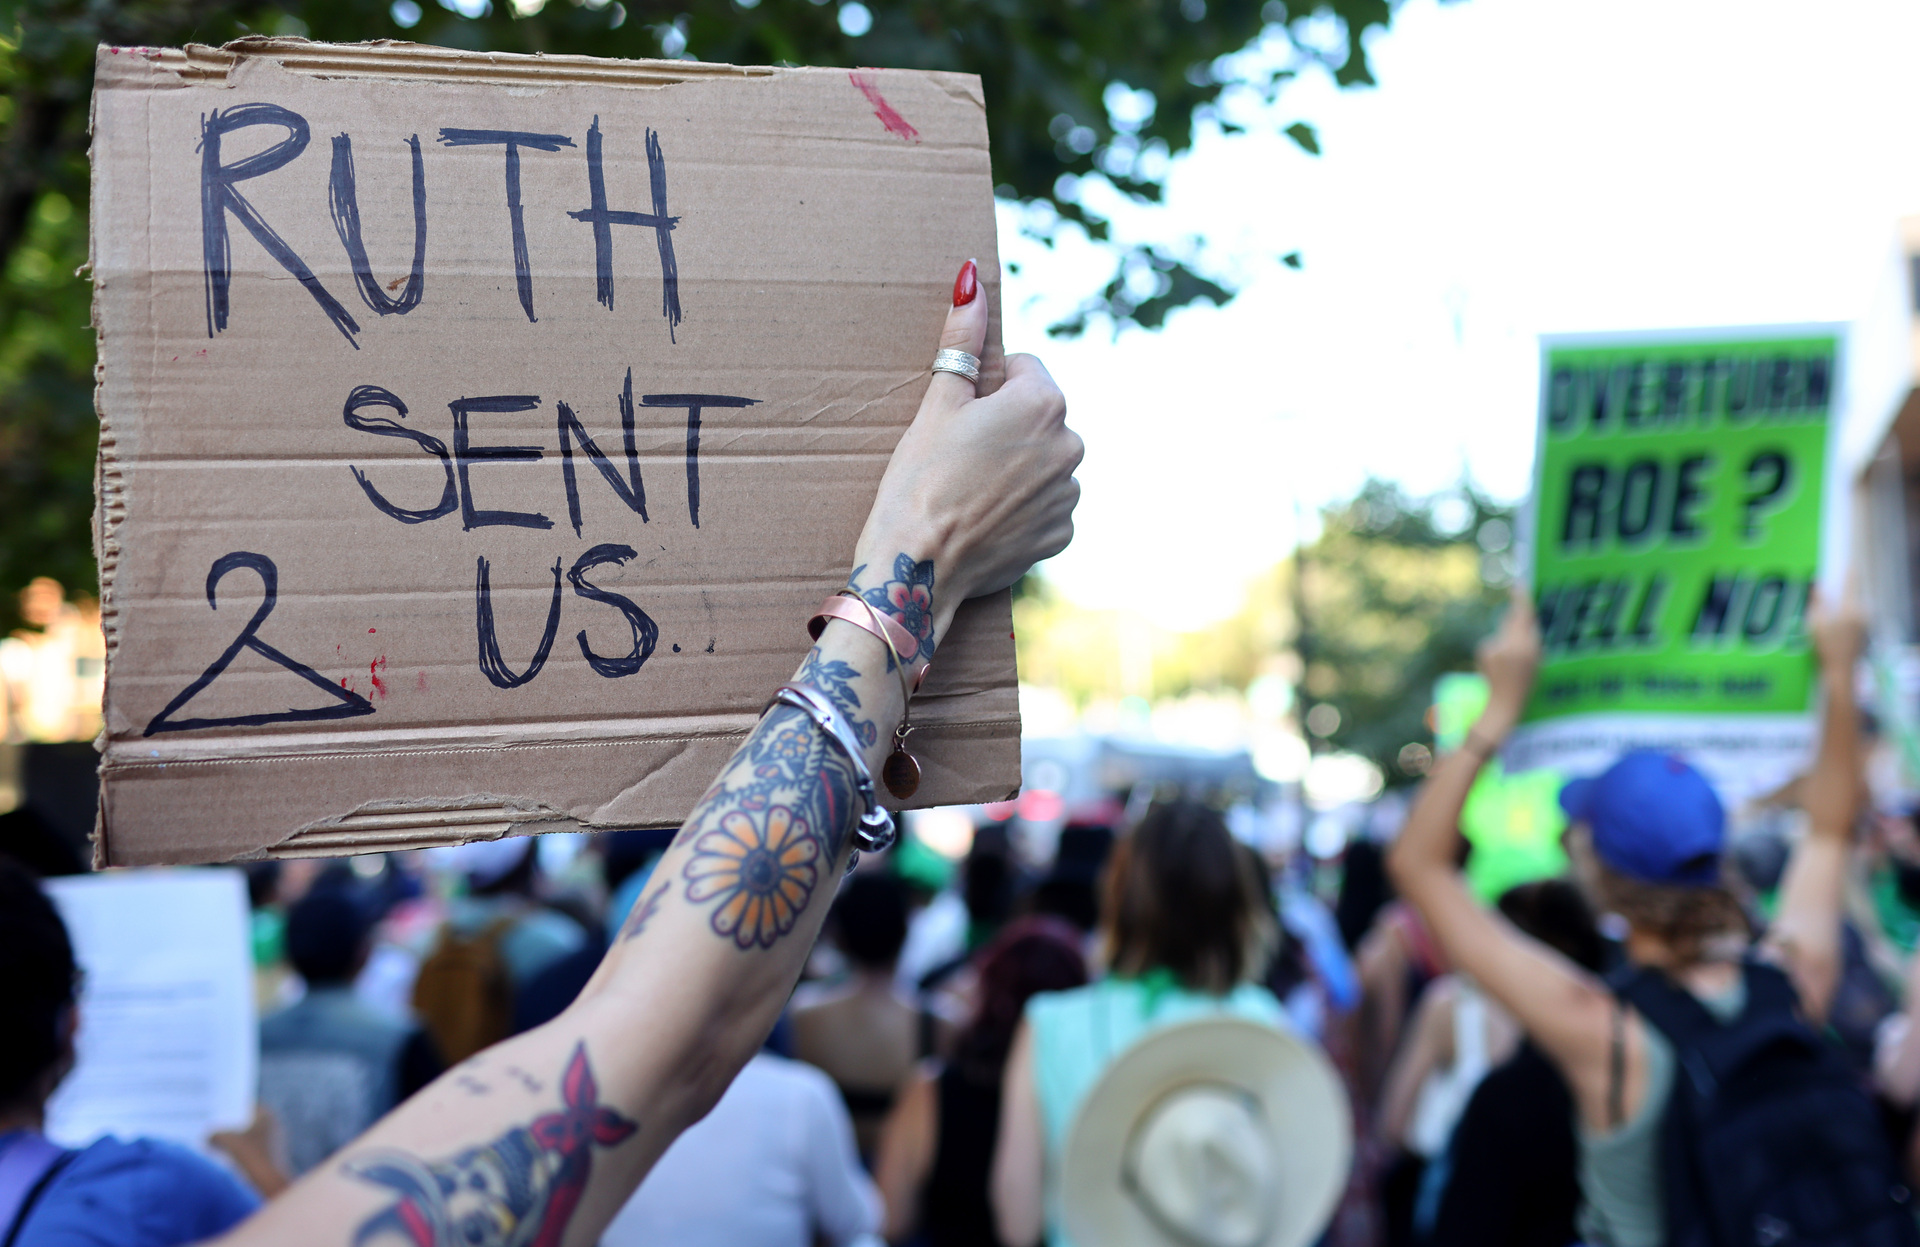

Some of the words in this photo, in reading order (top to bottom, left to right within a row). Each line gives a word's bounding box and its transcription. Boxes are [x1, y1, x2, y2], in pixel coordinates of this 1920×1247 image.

[195, 102, 682, 350] RUTH
[342, 366, 763, 540] SENT
[1549, 353, 1831, 430] OVERTURN
[1561, 453, 1714, 550] ROE
